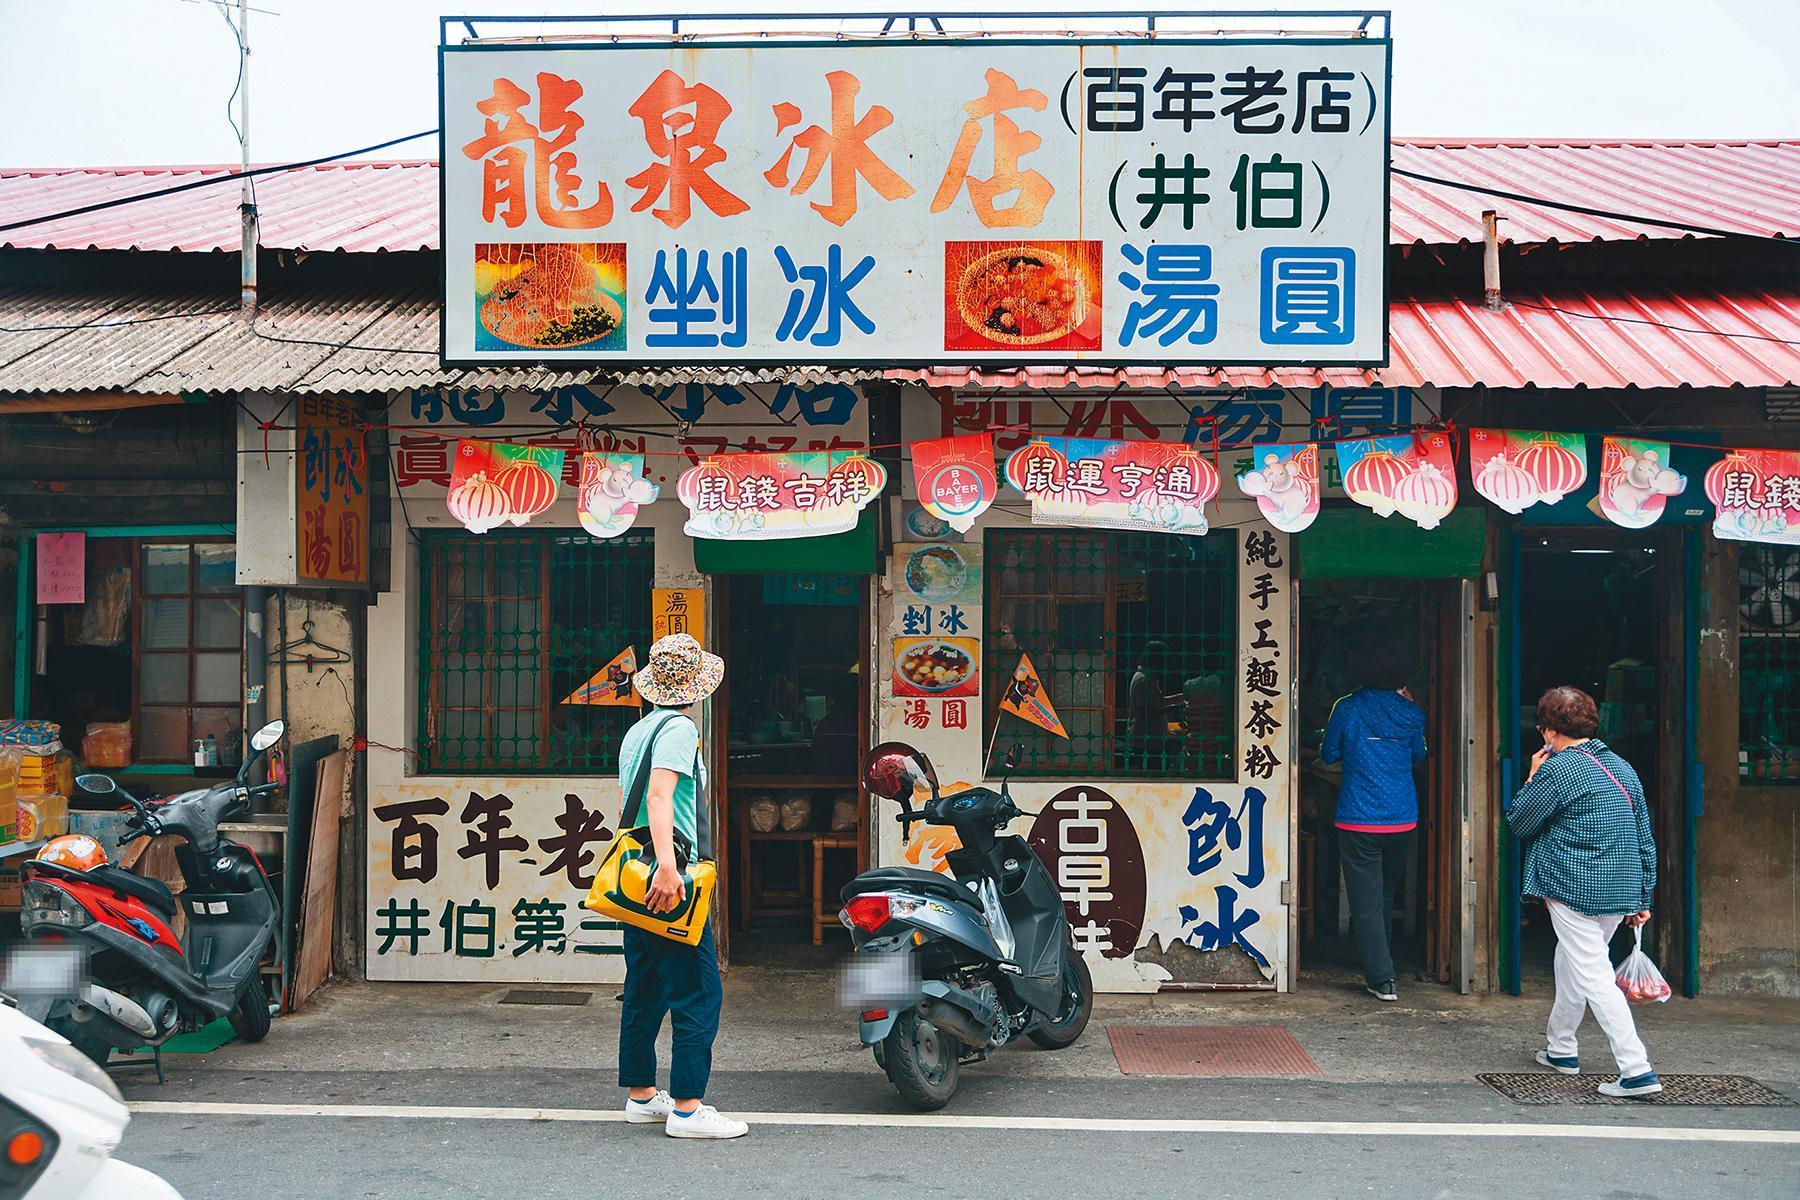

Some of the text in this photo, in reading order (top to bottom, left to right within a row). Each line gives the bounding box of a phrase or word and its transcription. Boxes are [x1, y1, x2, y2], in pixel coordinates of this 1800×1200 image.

[1060, 66, 1377, 136] (百年老店)
[462, 68, 1055, 230] 龍泉冰店
[1108, 152, 1330, 233] (井伯)
[644, 243, 876, 348] 剉冰
[1118, 243, 1356, 348] 湯圓
[697, 471, 870, 510] 鼠錢吉祥
[936, 484, 979, 497] BAYER
[1024, 456, 1199, 499] 鼠運亨通
[1723, 471, 1800, 512] 鼠錢
[304, 504, 361, 582] 湯圓
[665, 592, 688, 635] 湯圓
[902, 604, 969, 636] 剉冰
[903, 698, 968, 730] 湯圓
[373, 791, 614, 891] 百年老
[1179, 786, 1271, 968] 刨冰
